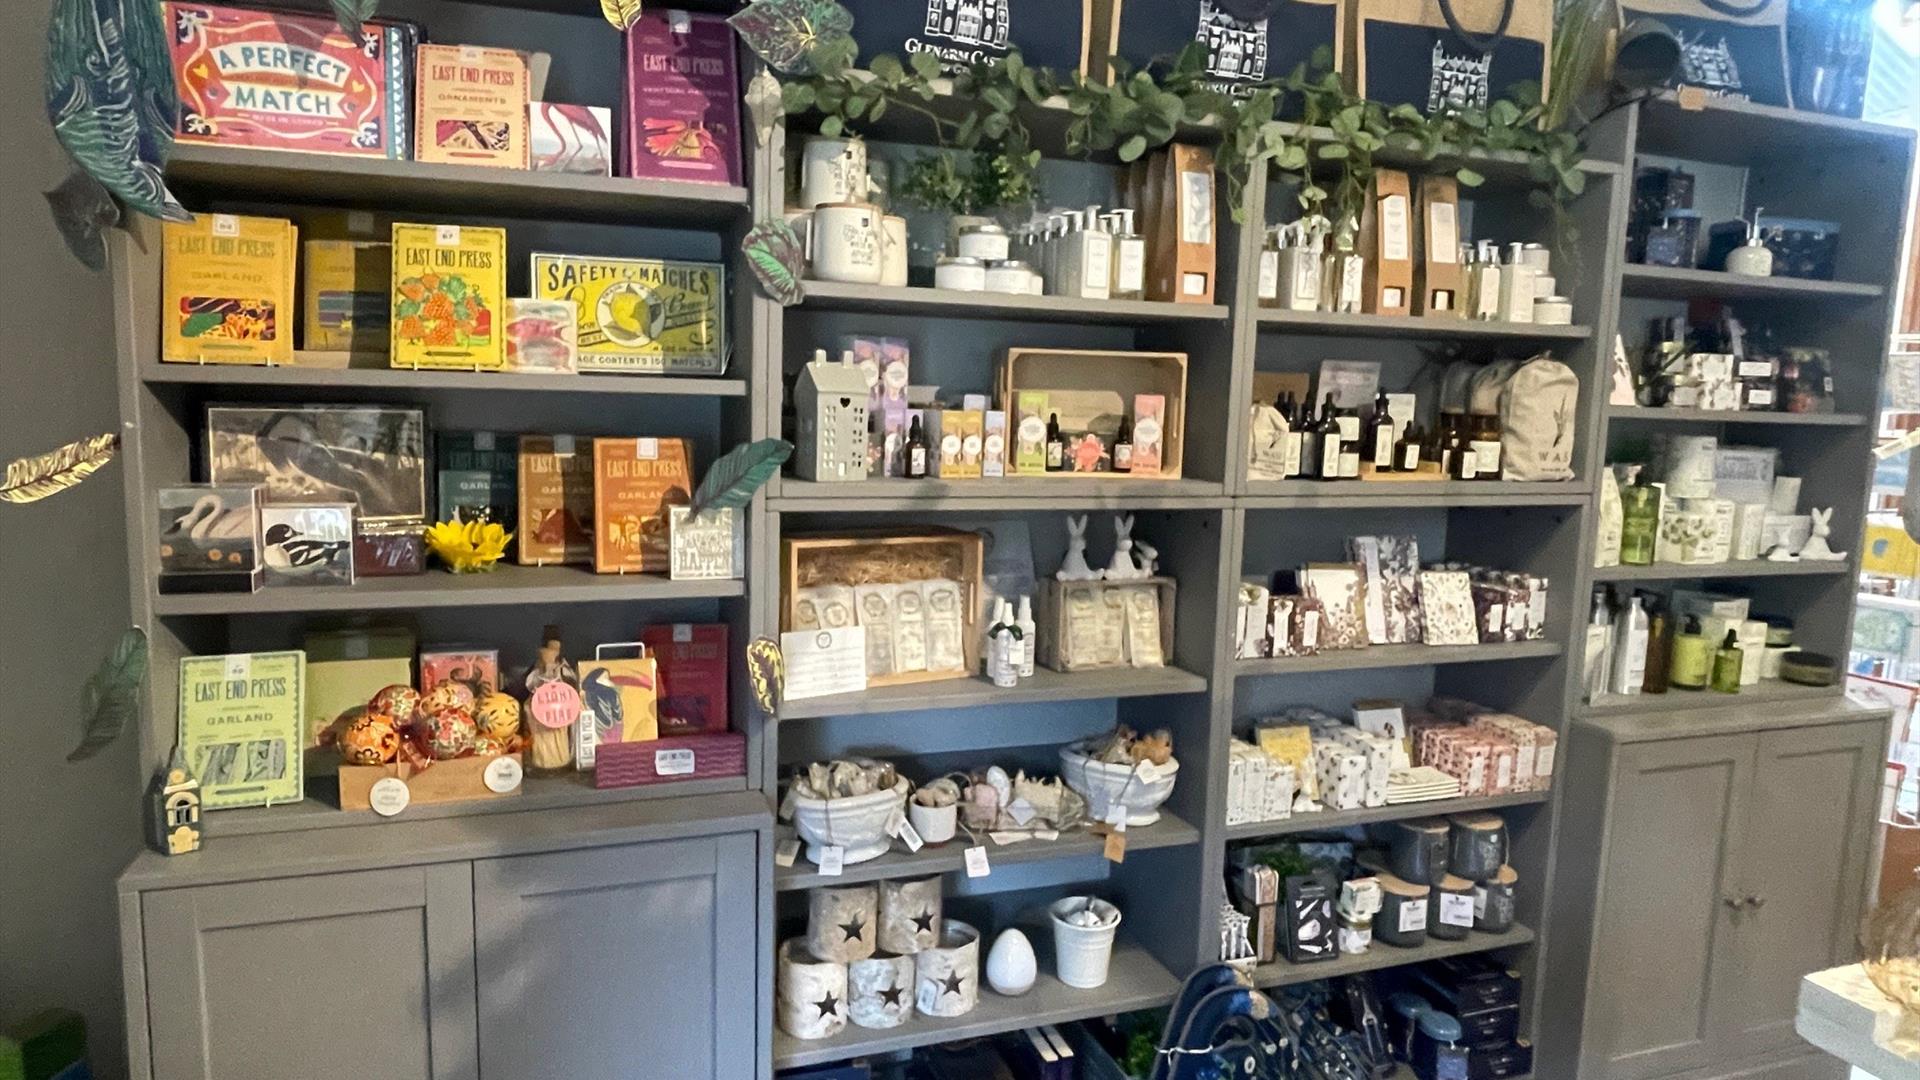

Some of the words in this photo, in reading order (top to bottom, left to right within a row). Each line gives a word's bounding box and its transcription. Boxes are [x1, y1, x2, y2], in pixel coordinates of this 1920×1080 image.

[219, 48, 238, 70] A
[240, 46, 347, 84] PERFECT
[643, 54, 667, 72] EAST
[432, 64, 457, 81] EAST
[460, 66, 480, 83] END
[482, 68, 515, 86] PRESS
[234, 85, 331, 115] MATCH
[438, 93, 507, 105] ORNAMENTS
[178, 236, 206, 255] EAST
[211, 237, 234, 256] END
[237, 238, 276, 258] PRESS
[405, 248, 432, 267] EAST
[435, 248, 457, 268] END
[459, 250, 493, 269] PRESS
[191, 271, 263, 283] GARLAND
[548, 263, 618, 292] SAFETY
[639, 267, 710, 296] MATCHES
[598, 356, 648, 365] CONTENTS
[530, 456, 553, 473] EAST
[606, 460, 629, 478] EAST
[632, 460, 651, 478] END
[652, 460, 683, 478] PRESS
[618, 491, 666, 500] GARLAN
[195, 681, 222, 703] EAST
[226, 680, 248, 700] END
[251, 677, 287, 698] PRESS
[206, 713, 274, 726] GARLAND
